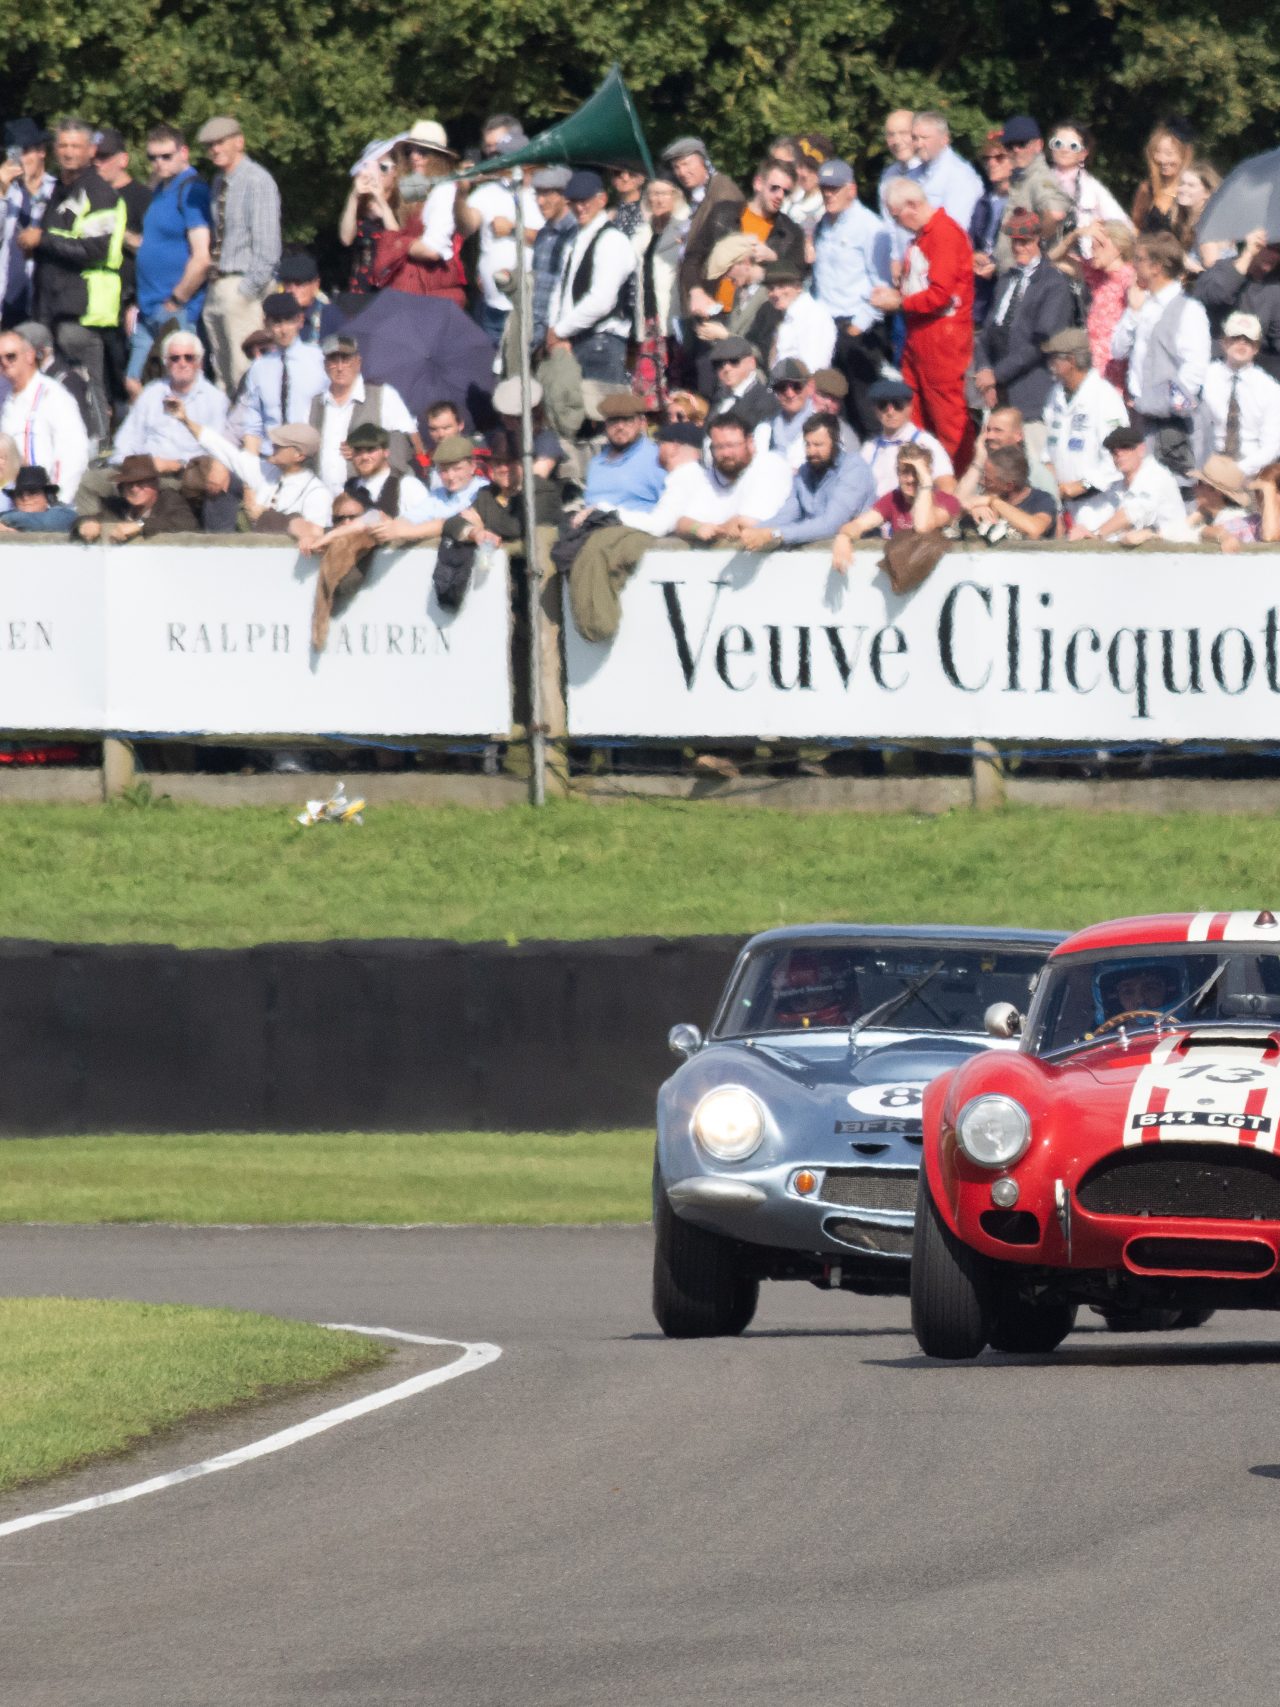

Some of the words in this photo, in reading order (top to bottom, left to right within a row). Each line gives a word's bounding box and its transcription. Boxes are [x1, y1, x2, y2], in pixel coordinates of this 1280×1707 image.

[166, 622, 291, 653] RALPH
[322, 622, 451, 656] AUREN
[655, 580, 908, 692] Veuve
[1177, 1064, 1266, 1084] 13
[1139, 1111, 1196, 1127] 644
[1207, 1113, 1265, 1129] CGT
